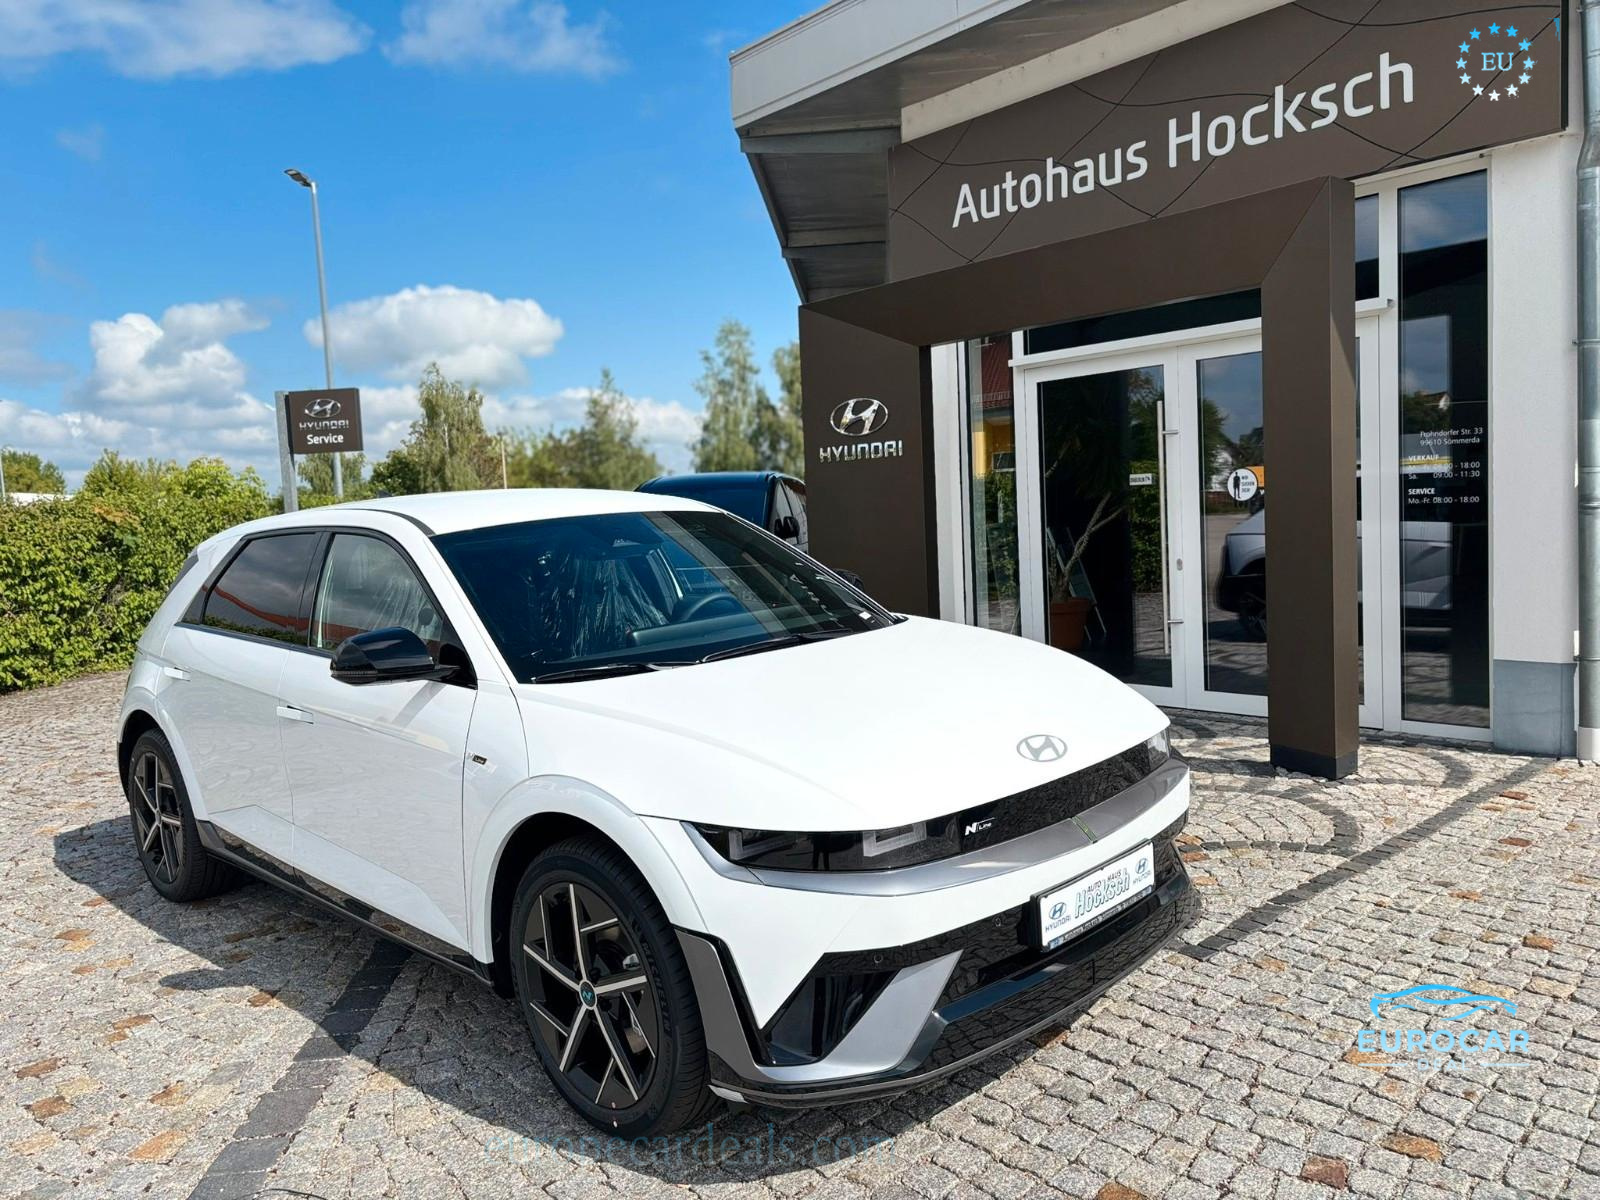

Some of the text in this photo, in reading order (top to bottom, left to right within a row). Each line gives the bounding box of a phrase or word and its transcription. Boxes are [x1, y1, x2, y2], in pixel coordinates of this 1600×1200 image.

[951, 52, 1414, 228] Autohaus Hocksch
[299, 420, 349, 430] HYUNDAI
[1461, 428, 1471, 436] Str.
[306, 433, 344, 445] Service
[819, 440, 903, 463] HYUNDAI
[1460, 461, 1480, 469] 18:00
[1408, 487, 1435, 495] SERVICE
[965, 822, 977, 836] N
[1075, 867, 1131, 919] Hocksch
[1045, 914, 1072, 932] HYUNDAI
